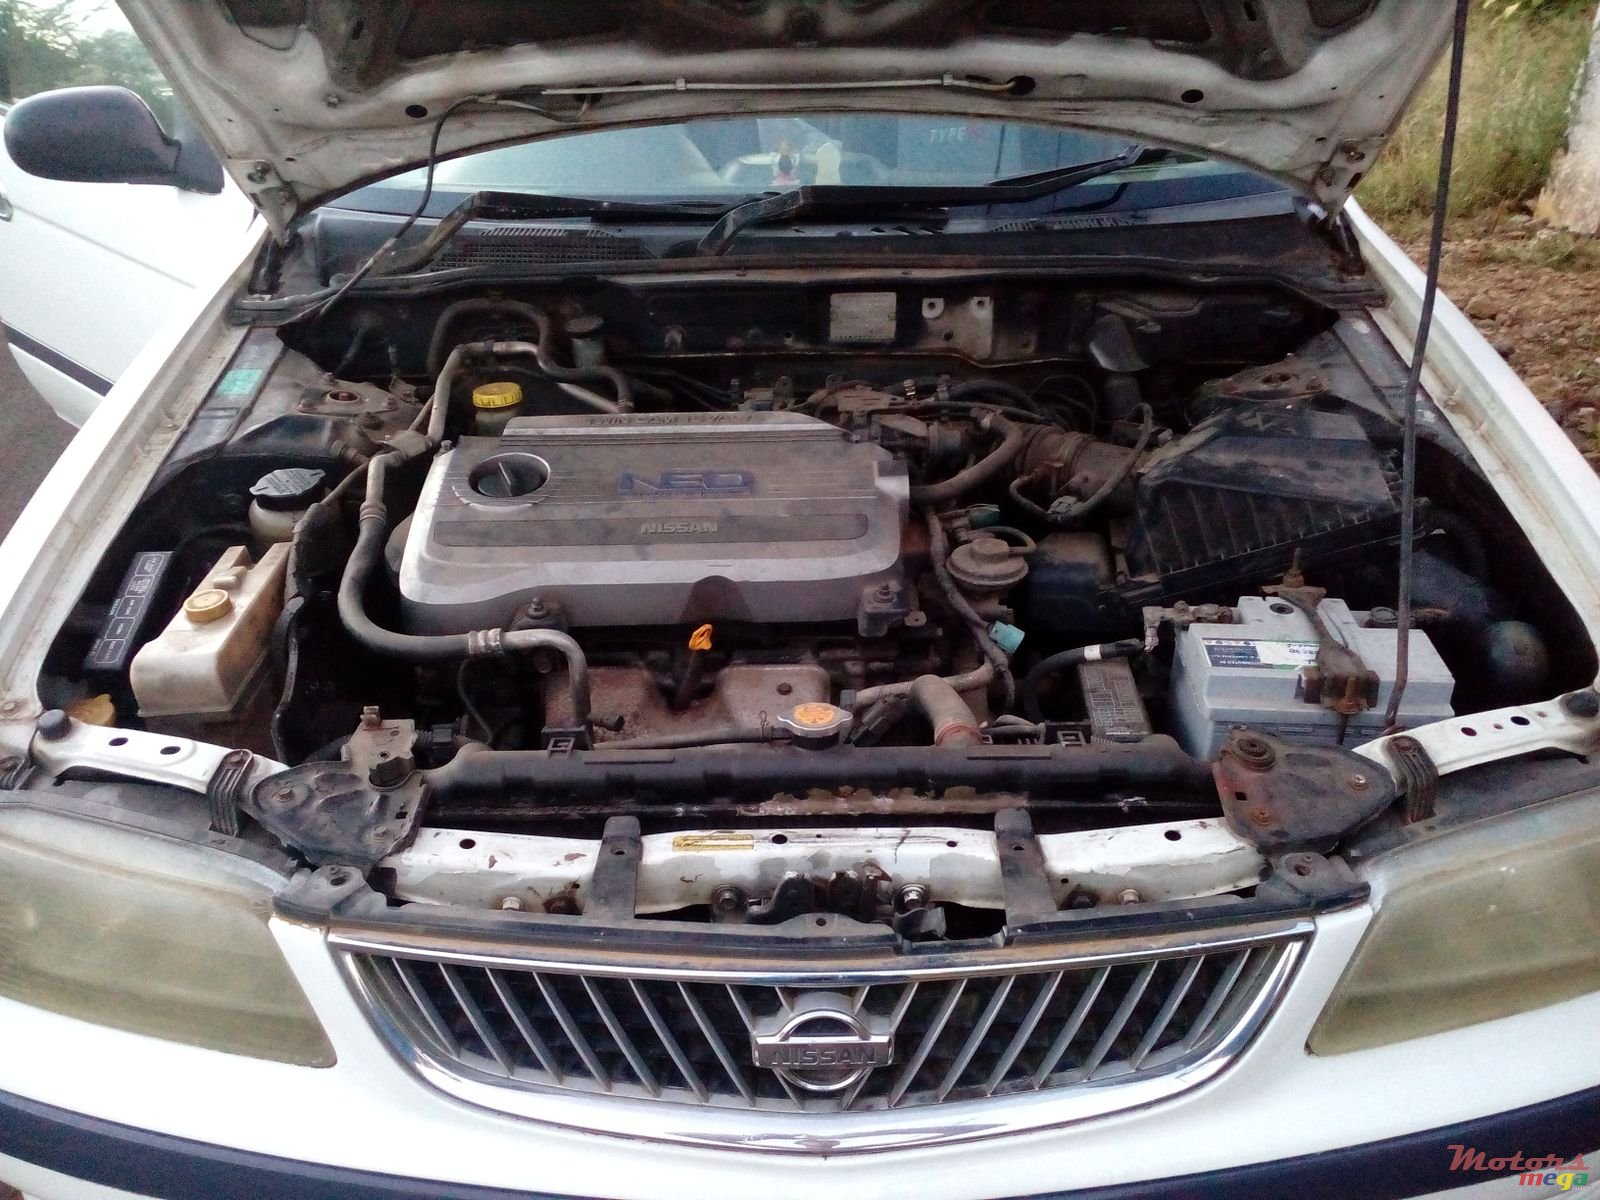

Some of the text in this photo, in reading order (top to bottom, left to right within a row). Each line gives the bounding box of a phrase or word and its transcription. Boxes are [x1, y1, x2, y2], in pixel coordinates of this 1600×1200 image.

[929, 127, 968, 143] TYPE
[640, 522, 719, 535] NISSAN
[771, 1046, 878, 1066] NISSAN
